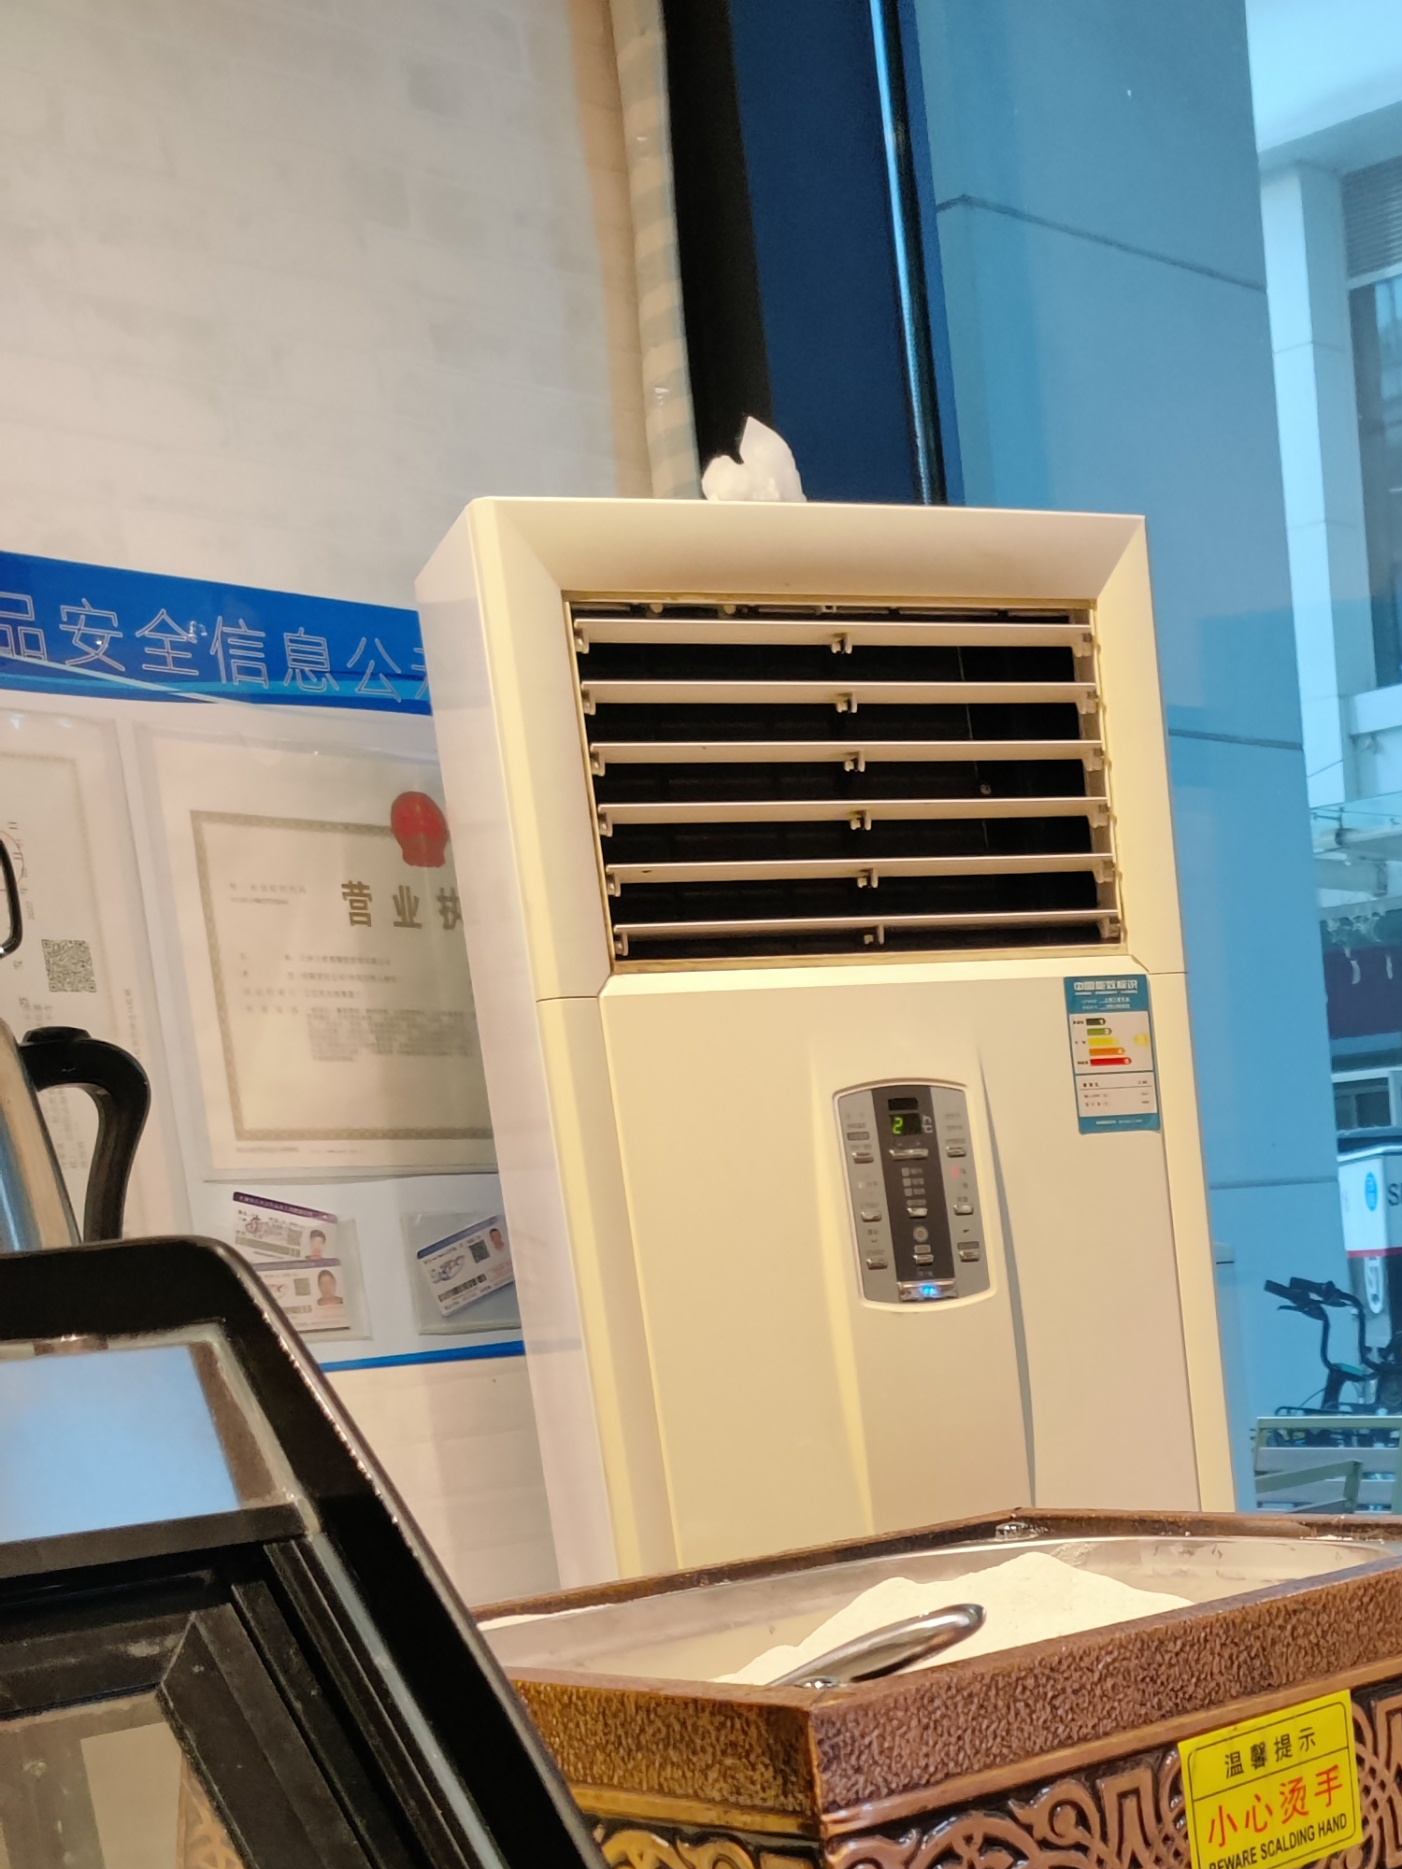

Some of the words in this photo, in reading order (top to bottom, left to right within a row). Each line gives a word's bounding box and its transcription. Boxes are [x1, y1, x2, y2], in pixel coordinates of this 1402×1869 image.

[1224, 1727, 1317, 1779] 温馨提示
[1208, 1764, 1343, 1849] 小心烫手
[1260, 1825, 1315, 1861] SCALDING
[1317, 1812, 1348, 1839] HAND
